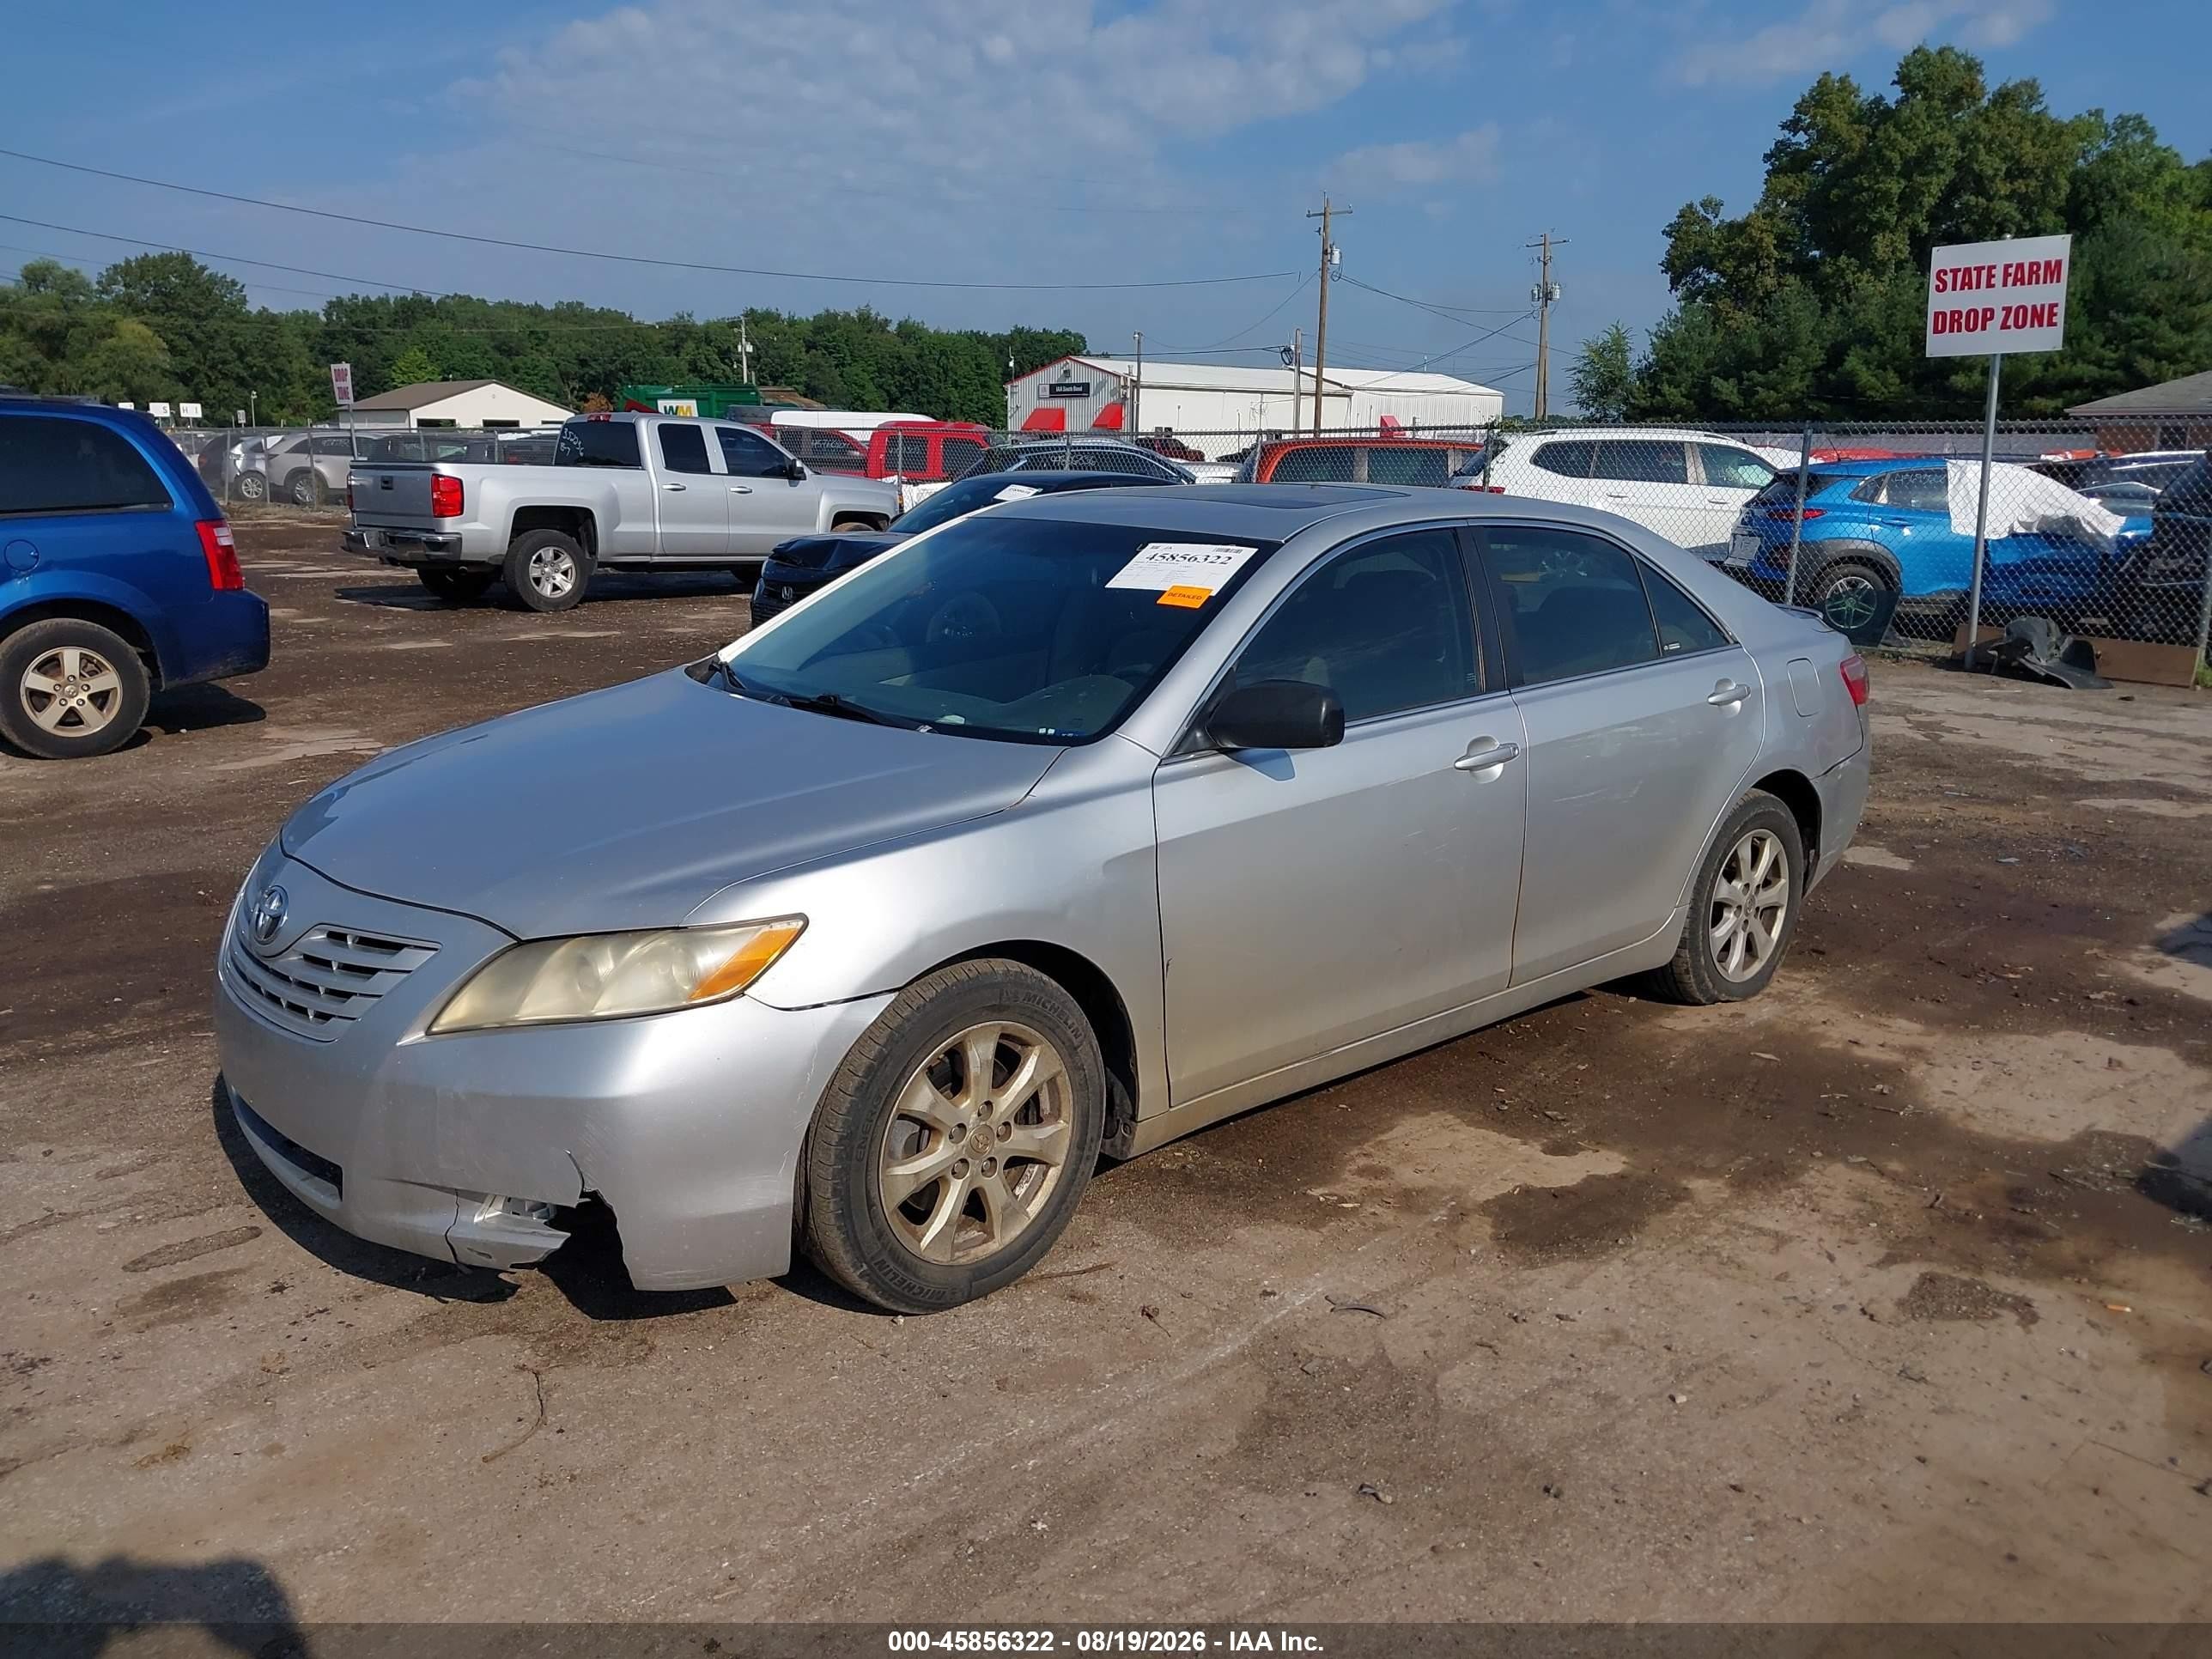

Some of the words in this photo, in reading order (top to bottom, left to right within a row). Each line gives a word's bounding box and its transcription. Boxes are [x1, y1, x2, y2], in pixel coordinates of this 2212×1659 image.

[1935, 264, 1997, 293] STATE
[2002, 259, 2063, 288] FARM
[1932, 307, 1995, 334] DROP
[2000, 302, 2059, 331] ZONE
[334, 368, 348, 382] DROP
[337, 386, 349, 399] ZONE
[161, 405, 168, 414] S
[182, 405, 188, 414] H
[663, 404, 692, 417] WM
[1146, 552, 1233, 565] 45856322
[1168, 592, 1202, 600] DETAILED
[1022, 993, 1085, 1042] MICHELIN
[872, 1257, 949, 1302] MICHELIN
